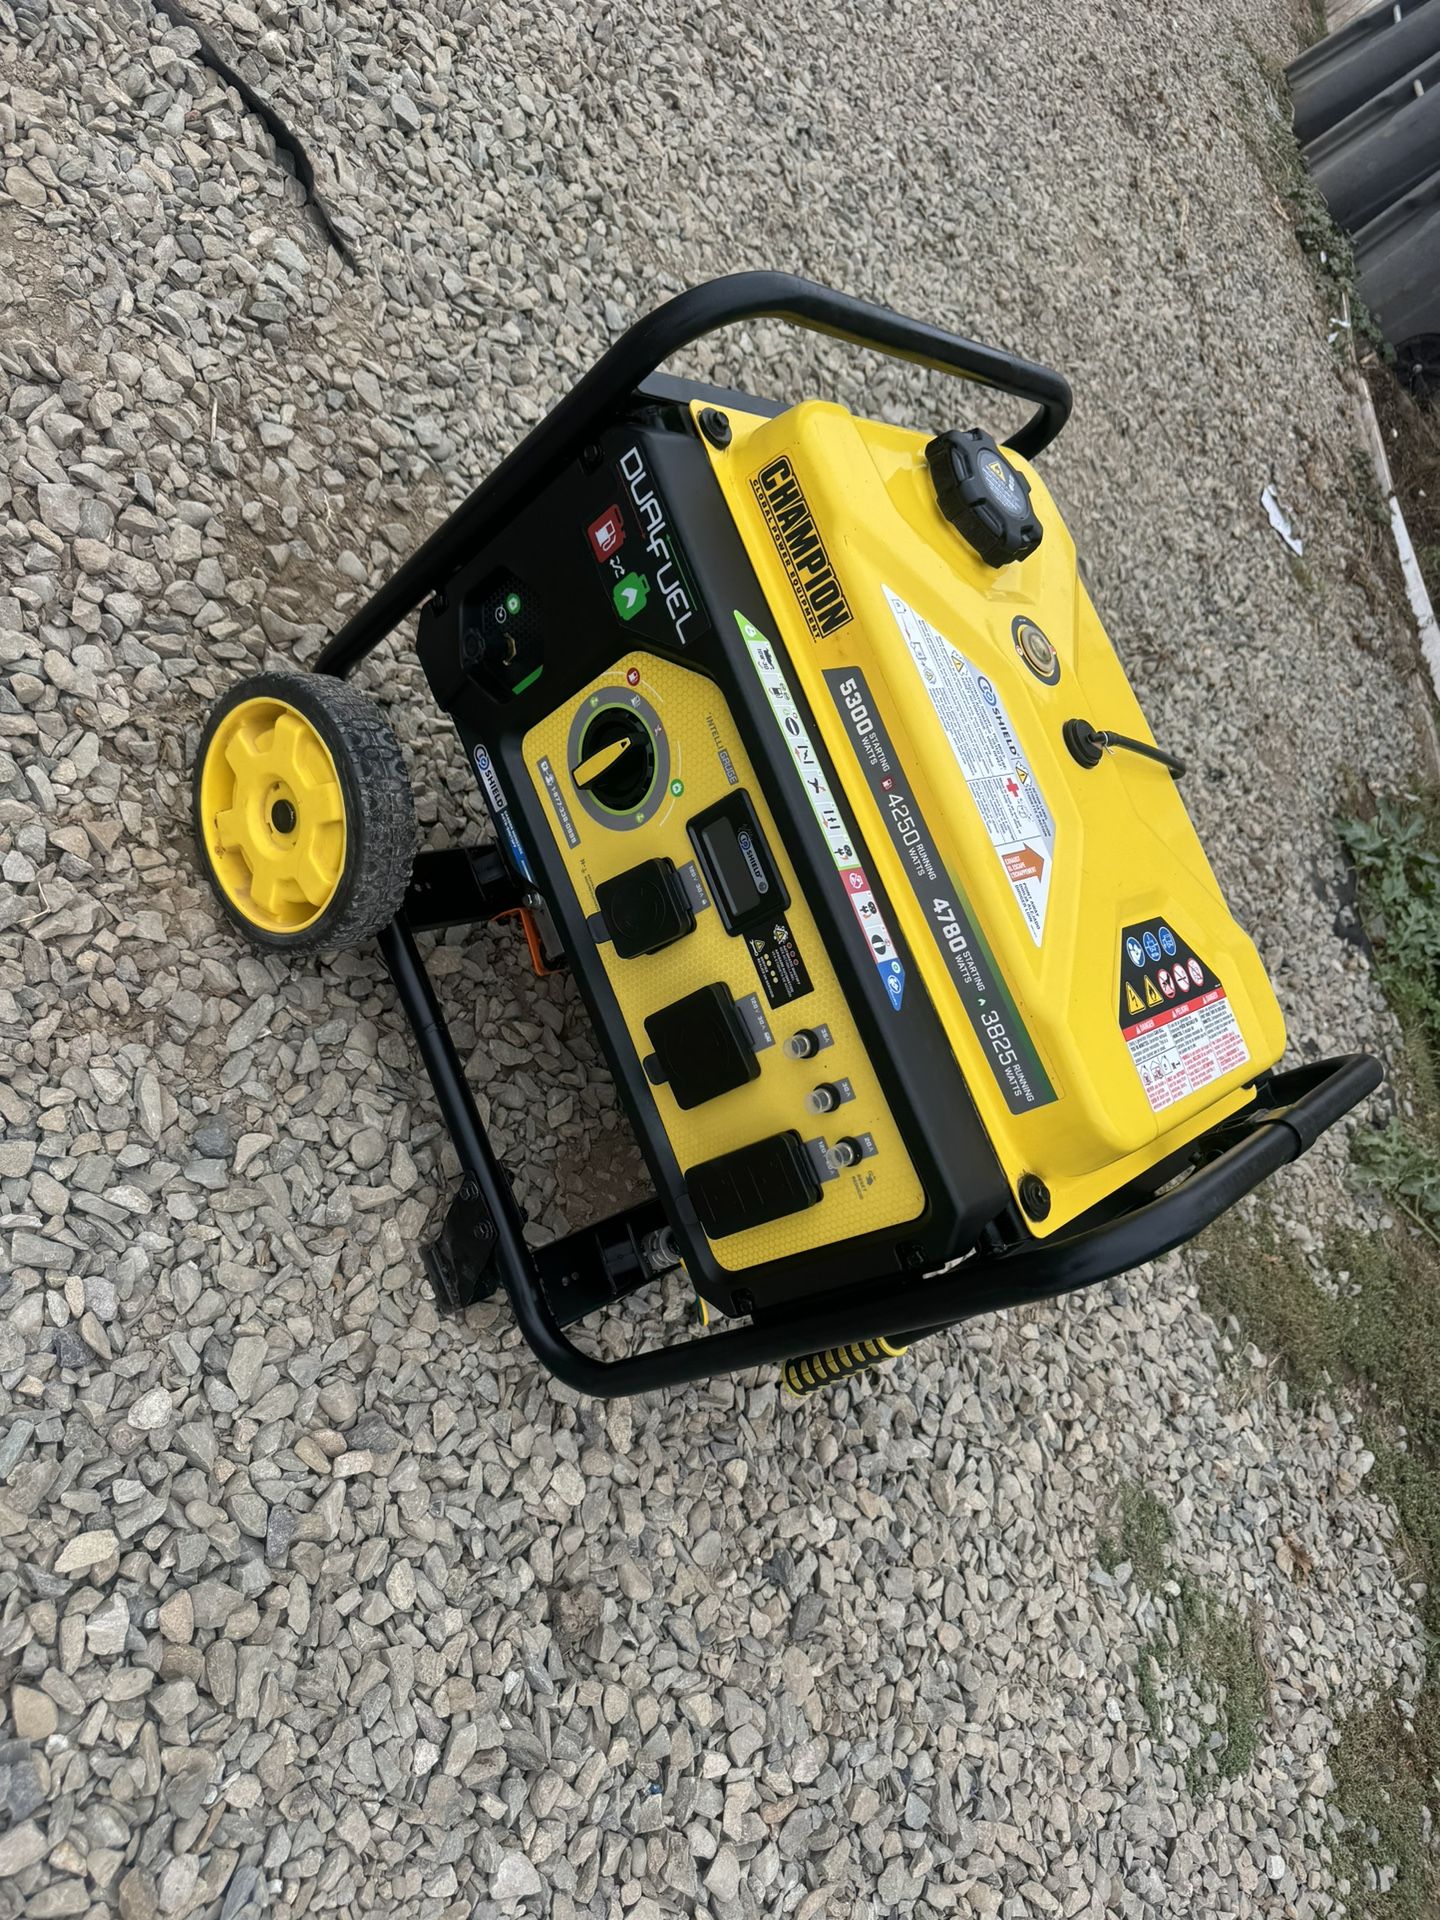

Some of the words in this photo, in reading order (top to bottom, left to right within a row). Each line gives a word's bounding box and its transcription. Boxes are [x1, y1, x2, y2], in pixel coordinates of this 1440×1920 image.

[752, 479, 773, 522] GLOBAL
[771, 526, 791, 567] POWER
[789, 571, 820, 639] EQUIPMENT
[759, 457, 850, 634] CHAMPION
[838, 677, 874, 736] 5300
[868, 732, 890, 771] STARTING
[991, 707, 1018, 755] SHIELD
[861, 736, 877, 765] WATTS
[484, 769, 503, 808] SHIELD
[885, 790, 920, 846] 4250
[915, 843, 936, 880] RUNNING
[746, 849, 760, 877] SHIELD
[908, 847, 925, 876] WATTS
[930, 894, 967, 953] 4780
[962, 950, 985, 991] STARTING
[954, 954, 971, 983] WATTS
[979, 1009, 1017, 1066] 3825
[1012, 1063, 1034, 1101] RUNNING
[1003, 1067, 1022, 1096] WATTS
[863, 1136, 874, 1152] 20A
